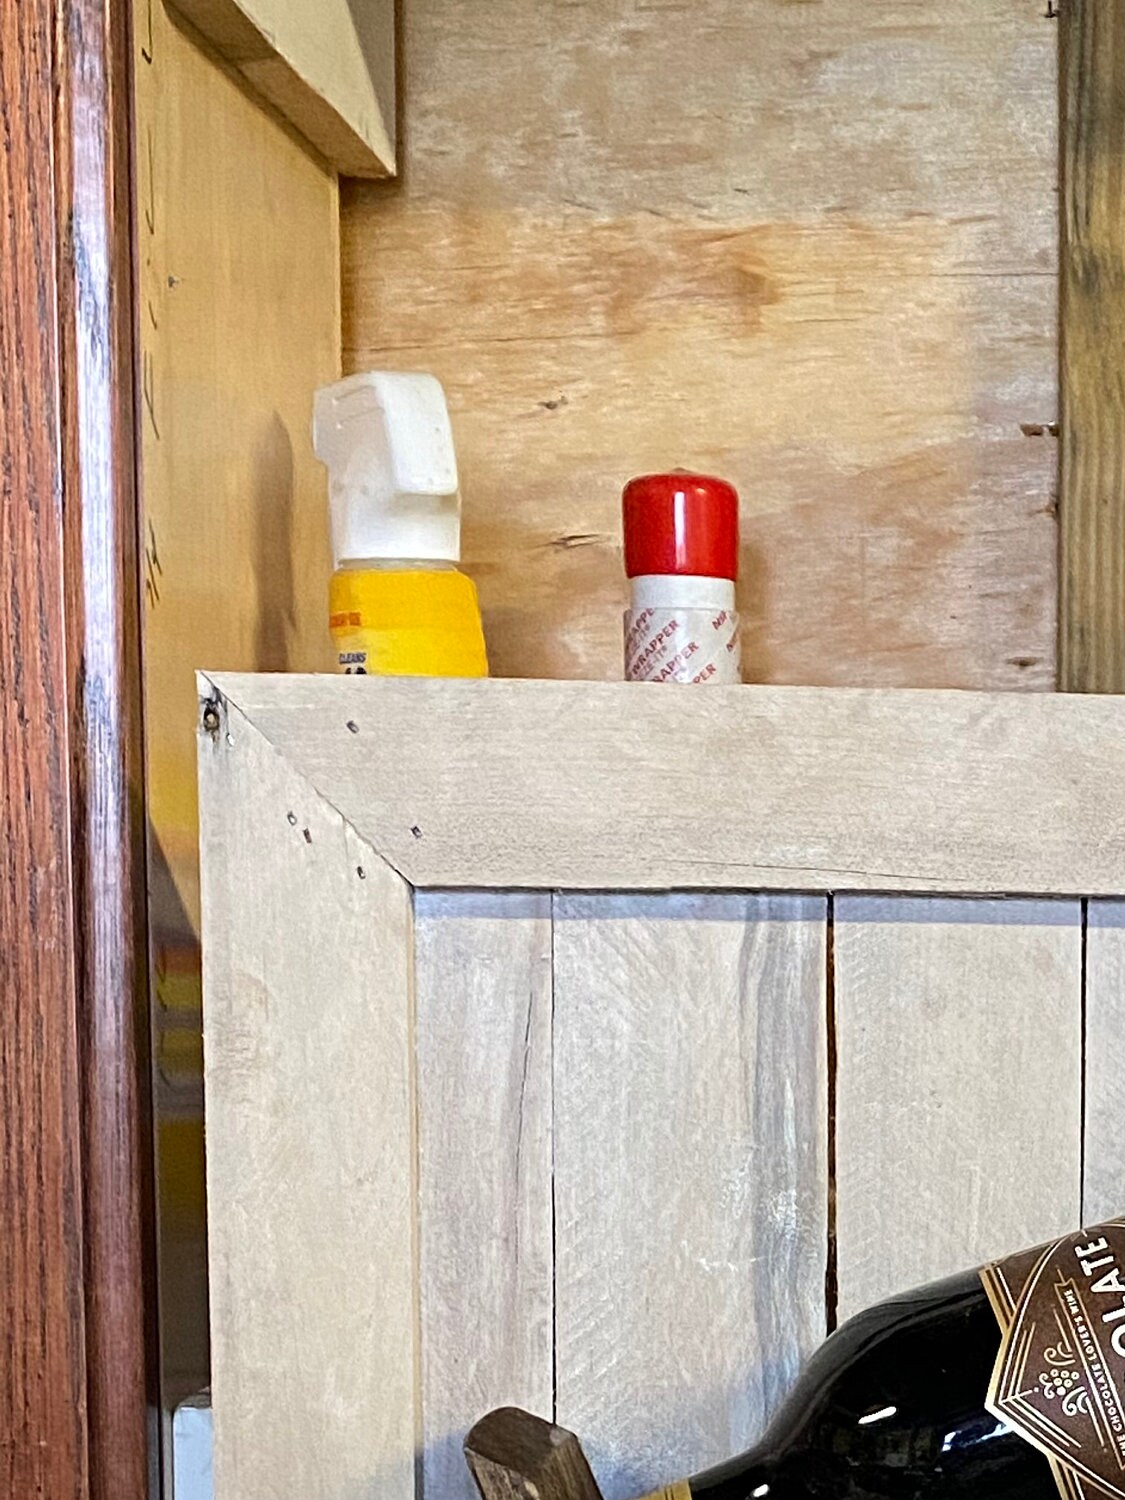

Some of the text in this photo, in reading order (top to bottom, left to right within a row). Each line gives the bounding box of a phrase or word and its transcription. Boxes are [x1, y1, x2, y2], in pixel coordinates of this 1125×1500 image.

[1063, 1288, 1080, 1315] WINE
[1073, 1315, 1098, 1361] LOVER'S
[1091, 1363, 1122, 1433] CHOCOLATE
